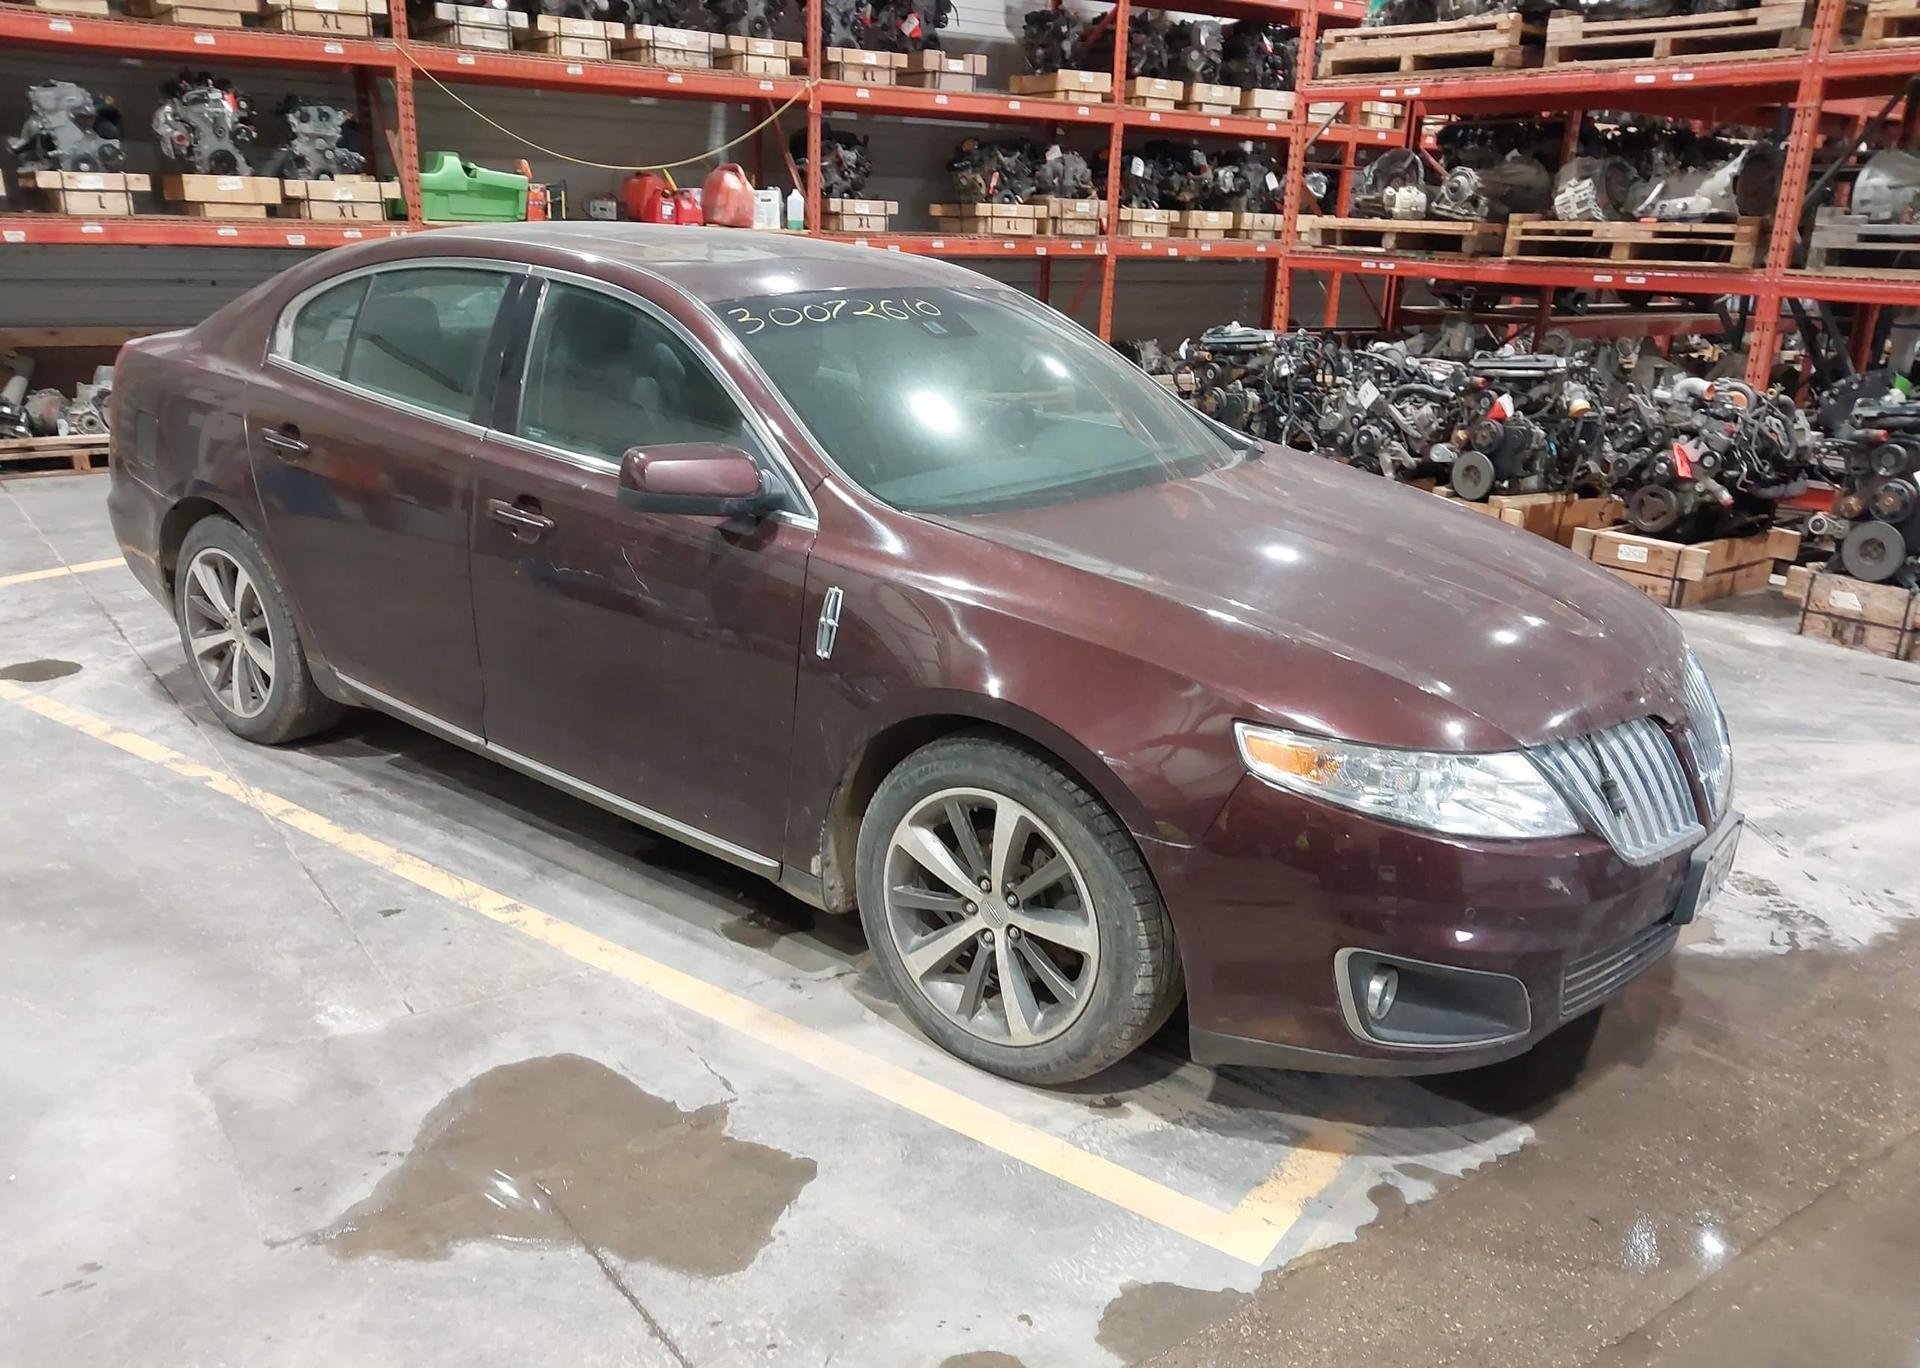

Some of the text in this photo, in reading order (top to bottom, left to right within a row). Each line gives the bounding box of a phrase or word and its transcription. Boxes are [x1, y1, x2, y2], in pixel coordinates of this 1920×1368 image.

[97, 194, 107, 209] L
[337, 204, 358, 218] XL
[727, 298, 942, 335] 30072610
